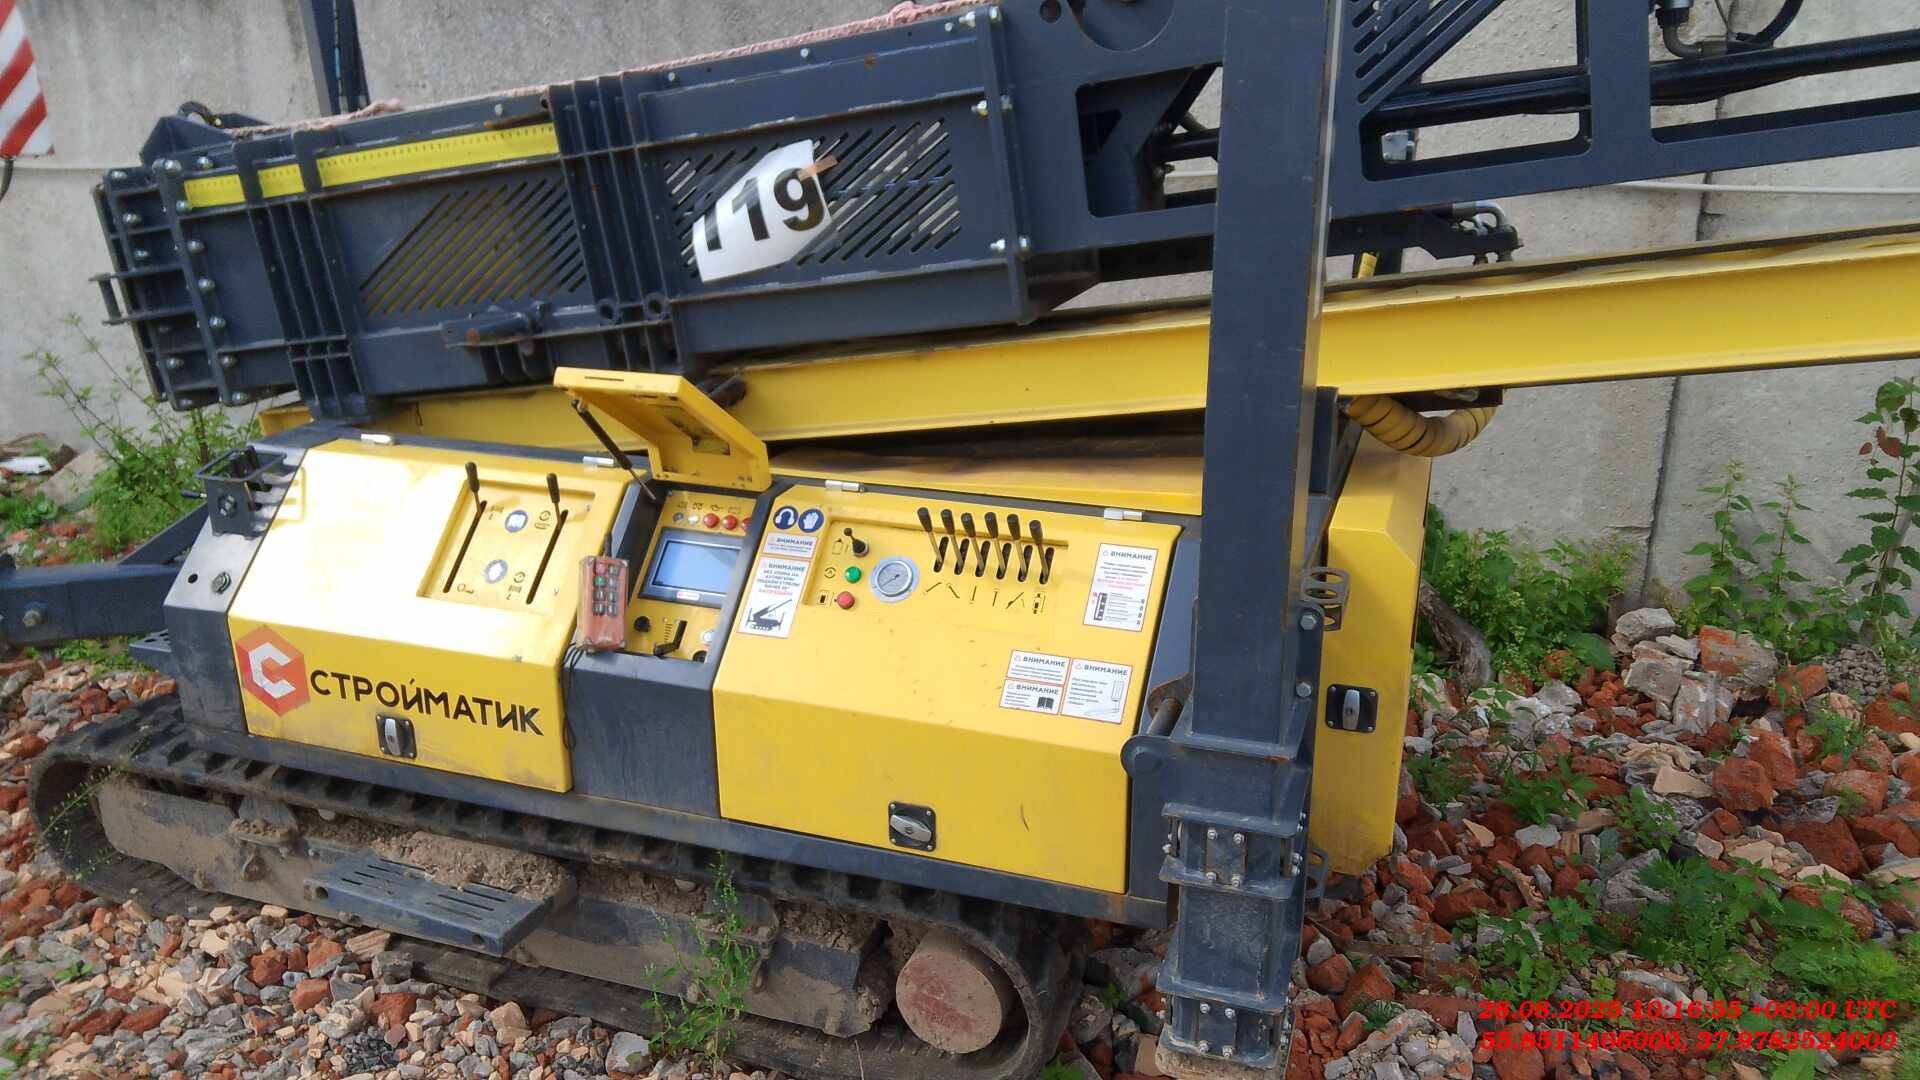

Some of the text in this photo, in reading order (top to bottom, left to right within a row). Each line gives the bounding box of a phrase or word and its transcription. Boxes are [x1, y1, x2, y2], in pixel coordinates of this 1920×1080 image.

[1110, 550, 1153, 561] ВНИМАНИЕ
[1022, 655, 1066, 668] ВНИМАНИЕ
[1083, 663, 1128, 676] ВНИМАНИЕ
[1015, 683, 1059, 695] ВНИМАНИЕ
[310, 669, 544, 736] СТРОЙМАТИК
